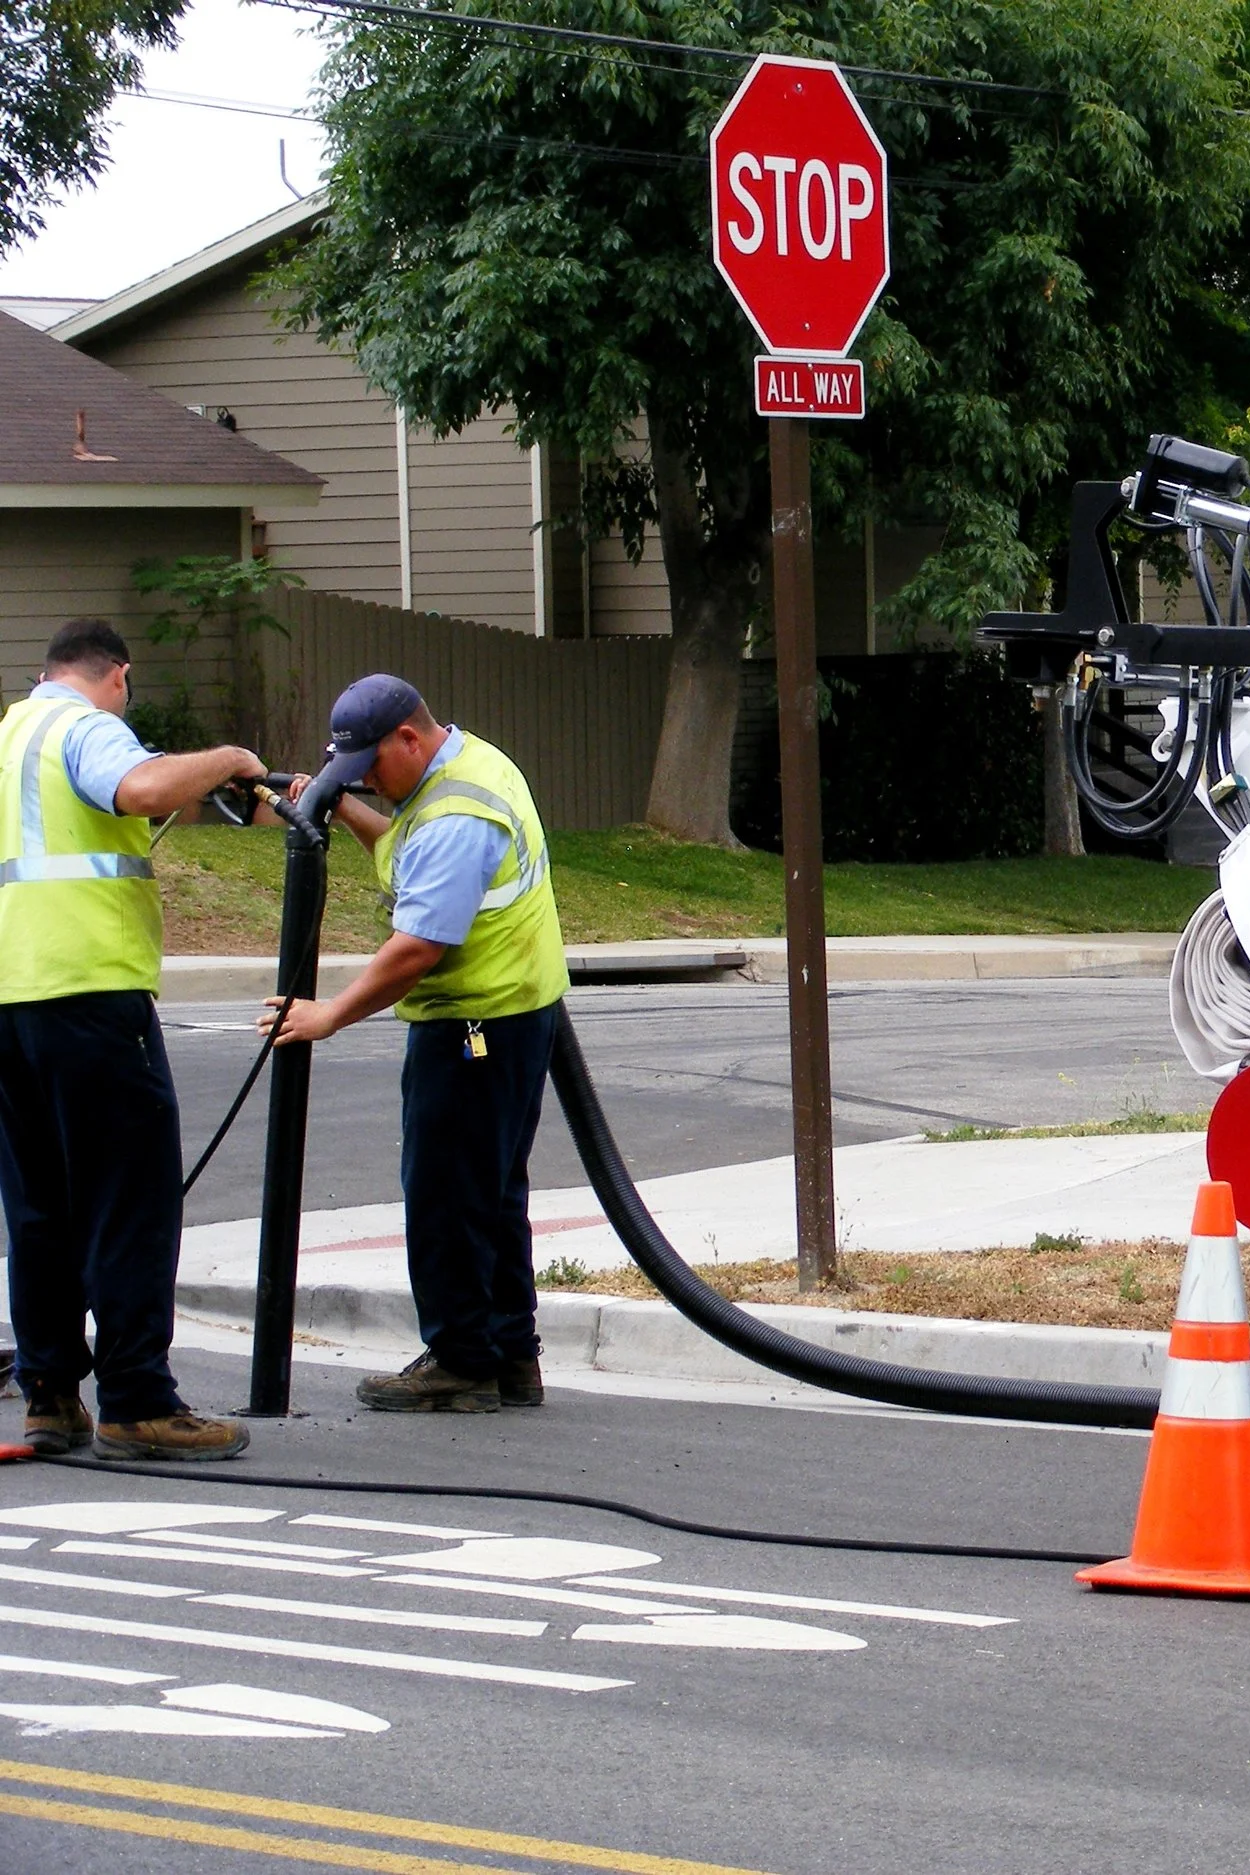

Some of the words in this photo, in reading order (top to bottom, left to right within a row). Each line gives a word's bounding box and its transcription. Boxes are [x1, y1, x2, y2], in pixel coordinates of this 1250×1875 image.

[727, 151, 875, 261] STOP
[766, 370, 804, 404] ALL
[814, 372, 854, 405] WAY
